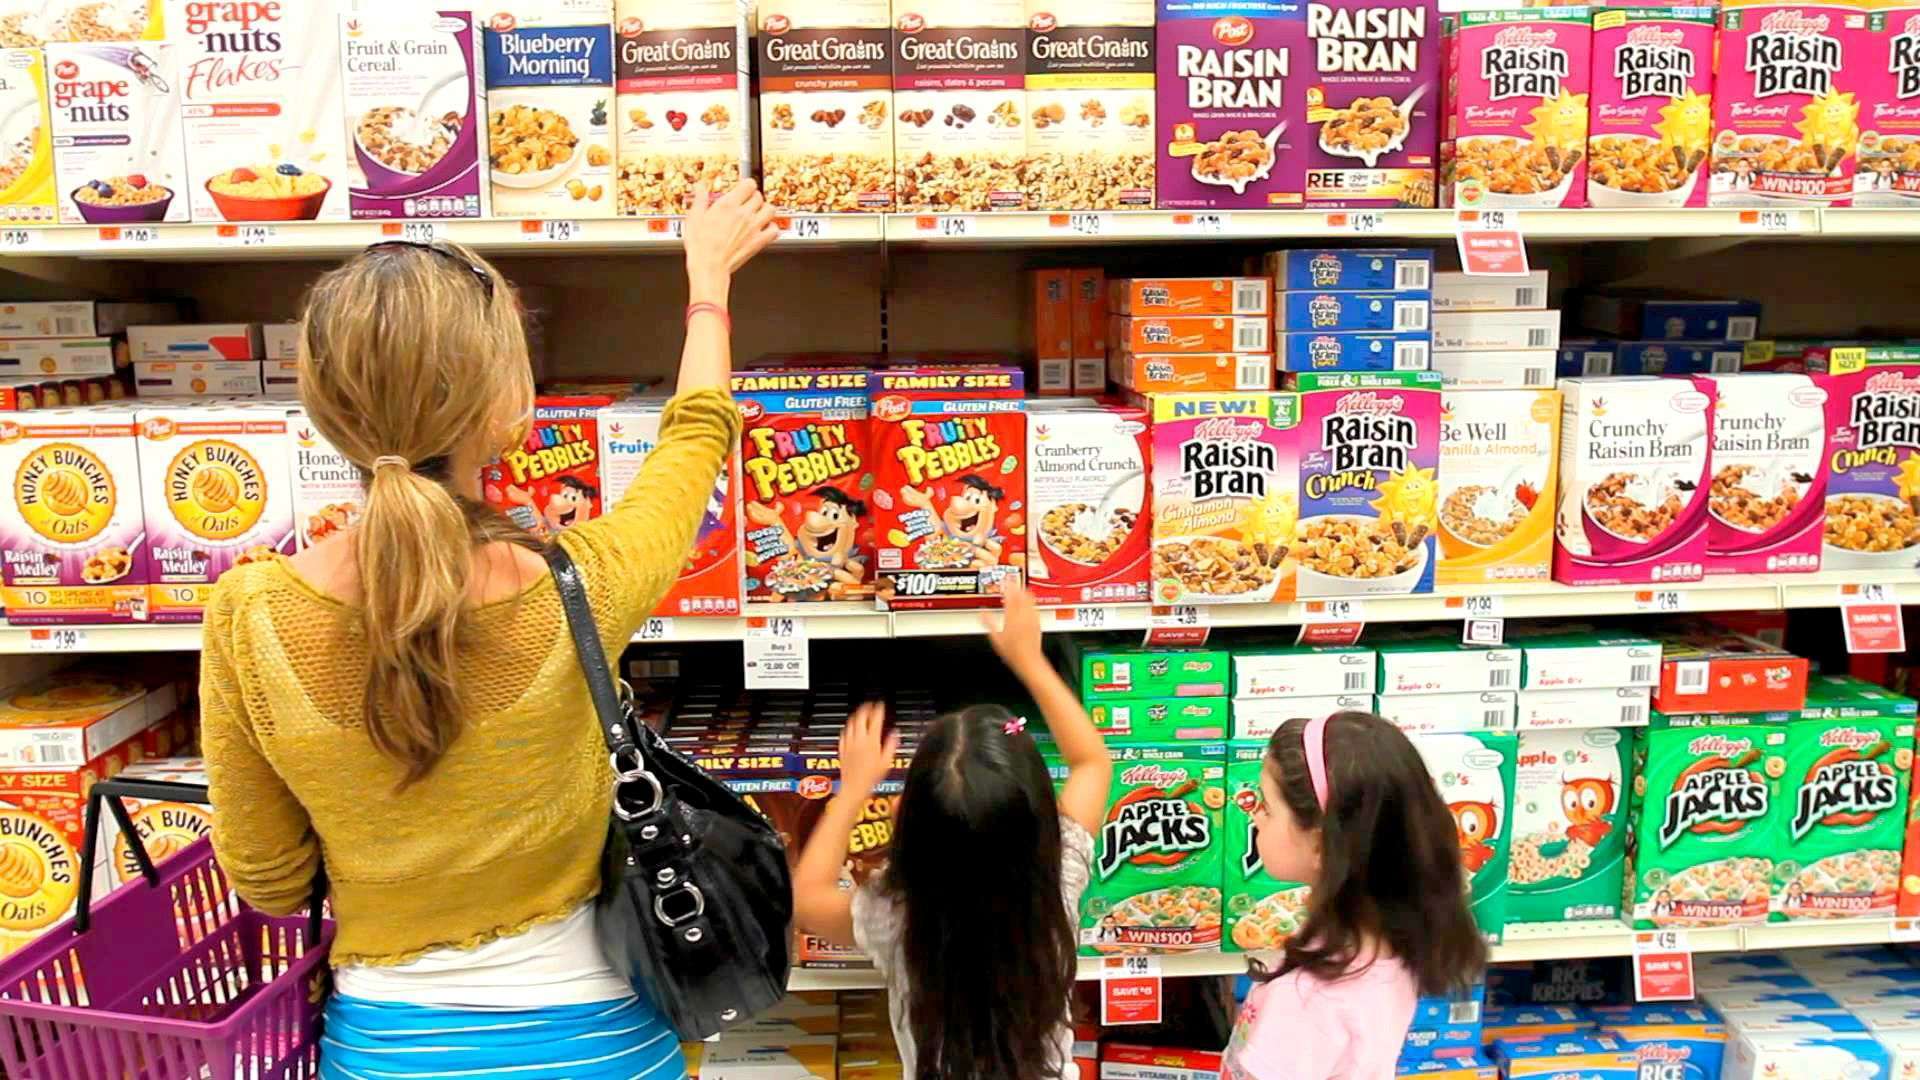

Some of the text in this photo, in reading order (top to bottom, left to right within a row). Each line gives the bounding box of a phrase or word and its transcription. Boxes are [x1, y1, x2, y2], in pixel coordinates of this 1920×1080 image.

[185, 2, 281, 34] grape
[1307, 7, 1425, 38] RAISIN
[1217, 22, 1249, 39] Post
[347, 40, 448, 56] Fruit & Grain
[500, 33, 596, 57] Blueberry
[622, 37, 731, 64] Great Grains
[767, 37, 885, 61] Great Grains
[900, 36, 1018, 60] Great Grains
[1032, 35, 1149, 59] Great Grains
[1317, 37, 1416, 71] BRAN
[1750, 36, 1838, 67] Raisin
[347, 58, 396, 73] Cereal
[510, 57, 590, 78] Morning
[1177, 45, 1289, 77] RAISIN
[1485, 47, 1565, 75] Raisin
[1618, 47, 1692, 74] Raisin
[186, 54, 284, 99] Flakes
[1494, 72, 1558, 97] Bran
[1626, 71, 1683, 96] Bran
[1759, 65, 1828, 94] Bran
[55, 80, 129, 108] grape
[1188, 76, 1282, 108] BRAN
[730, 374, 867, 391] FAMILY SIZE
[883, 375, 1012, 389] FAMILY SIZE
[536, 408, 577, 419] GLUTEN
[785, 397, 833, 409] GLUTEN
[943, 402, 987, 412] GLUTEN
[1174, 400, 1257, 417] NEW!
[1336, 391, 1404, 416] Kellogg's
[1854, 394, 1920, 423] Raisi
[1196, 419, 1263, 442] Kellogg's
[1325, 416, 1413, 447] Raisin
[1467, 423, 1507, 441] Well
[1588, 419, 1668, 438] Crunchy
[1035, 444, 1103, 458] Cranberry
[1485, 442, 1537, 456] Almond
[1588, 439, 1693, 460] Raisin Bran
[1767, 433, 1810, 451] Bran
[298, 451, 348, 470] Honey
[1034, 457, 1136, 472] Almond Crunch
[1184, 441, 1275, 473] Raisin
[1336, 444, 1404, 471] Bran
[1831, 447, 1897, 474] Crunch
[21, 450, 109, 505] HONEY BUNCHES
[172, 447, 260, 502] HONEY BUNCHES
[299, 467, 361, 481] Crunch
[1194, 470, 1265, 498] Bran
[1305, 470, 1377, 499] Crunch
[1163, 500, 1233, 522] Cinnamon
[1183, 510, 1237, 530] Almond
[52, 520, 89, 535] Oats
[202, 514, 239, 531] Oats
[5, 551, 43, 563] Raisin
[153, 547, 193, 560] Raisin
[14, 562, 60, 577] Medley
[162, 559, 207, 575] Medley
[896, 573, 937, 594] $100
[25, 591, 47, 605] 10
[173, 588, 194, 602] 10
[1690, 735, 1751, 757] Kellogg's
[1821, 728, 1881, 751] Kellogg's
[737, 757, 784, 769] SIZE
[1816, 763, 1876, 784] APPLE
[21, 774, 68, 787] SIZE
[803, 780, 828, 794] Post
[1122, 766, 1187, 787] Kellogg's
[1685, 771, 1746, 793] APPLE
[1120, 801, 1186, 824] APPLE
[1663, 785, 1766, 841] JACKS
[1795, 777, 1894, 838] JACKS
[1, 817, 71, 884] BUNCHES
[1101, 817, 1207, 871] JACKS
[1, 902, 47, 921] Oats
